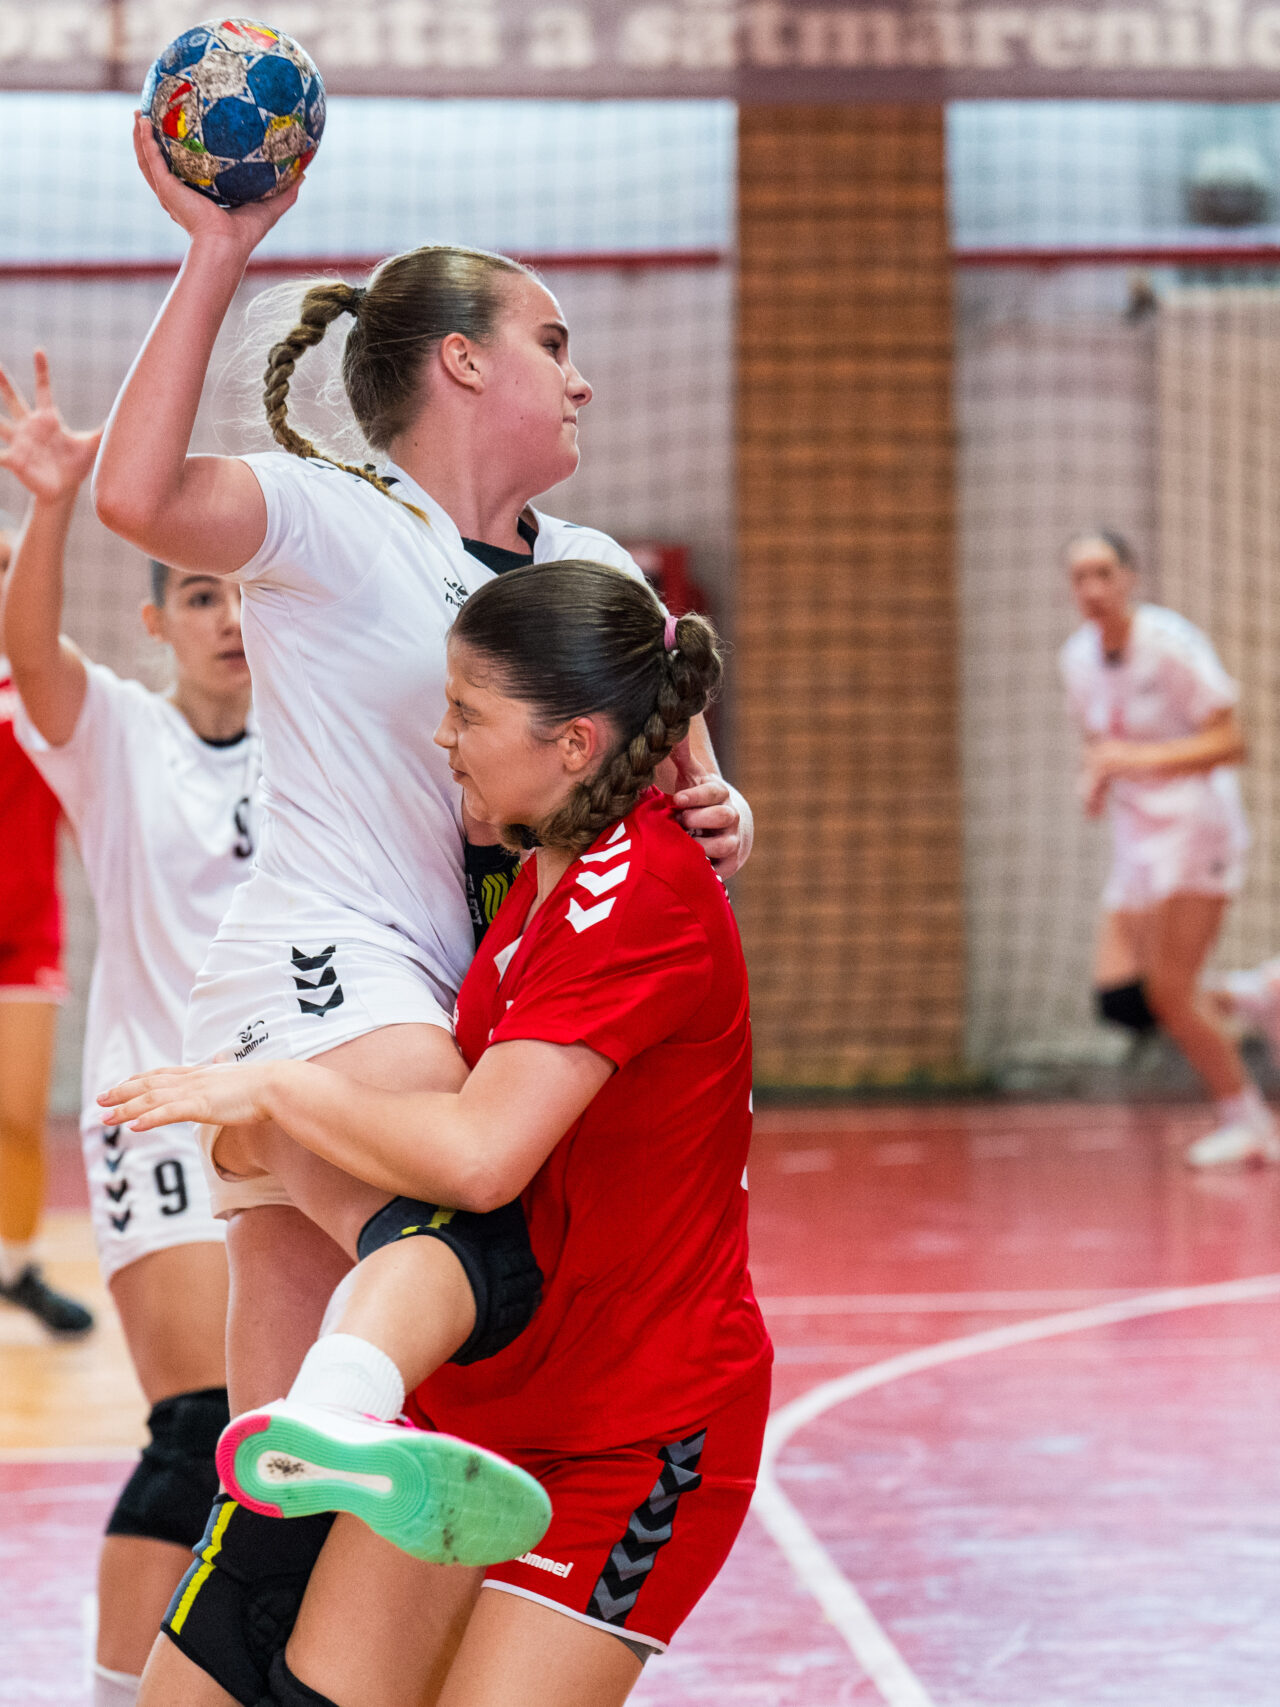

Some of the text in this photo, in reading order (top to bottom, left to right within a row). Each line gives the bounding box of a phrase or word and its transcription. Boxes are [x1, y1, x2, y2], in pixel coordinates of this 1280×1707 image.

[233, 1032, 269, 1062] hummel
[154, 1159, 188, 1217] 9
[514, 1551, 574, 1578] ummel
